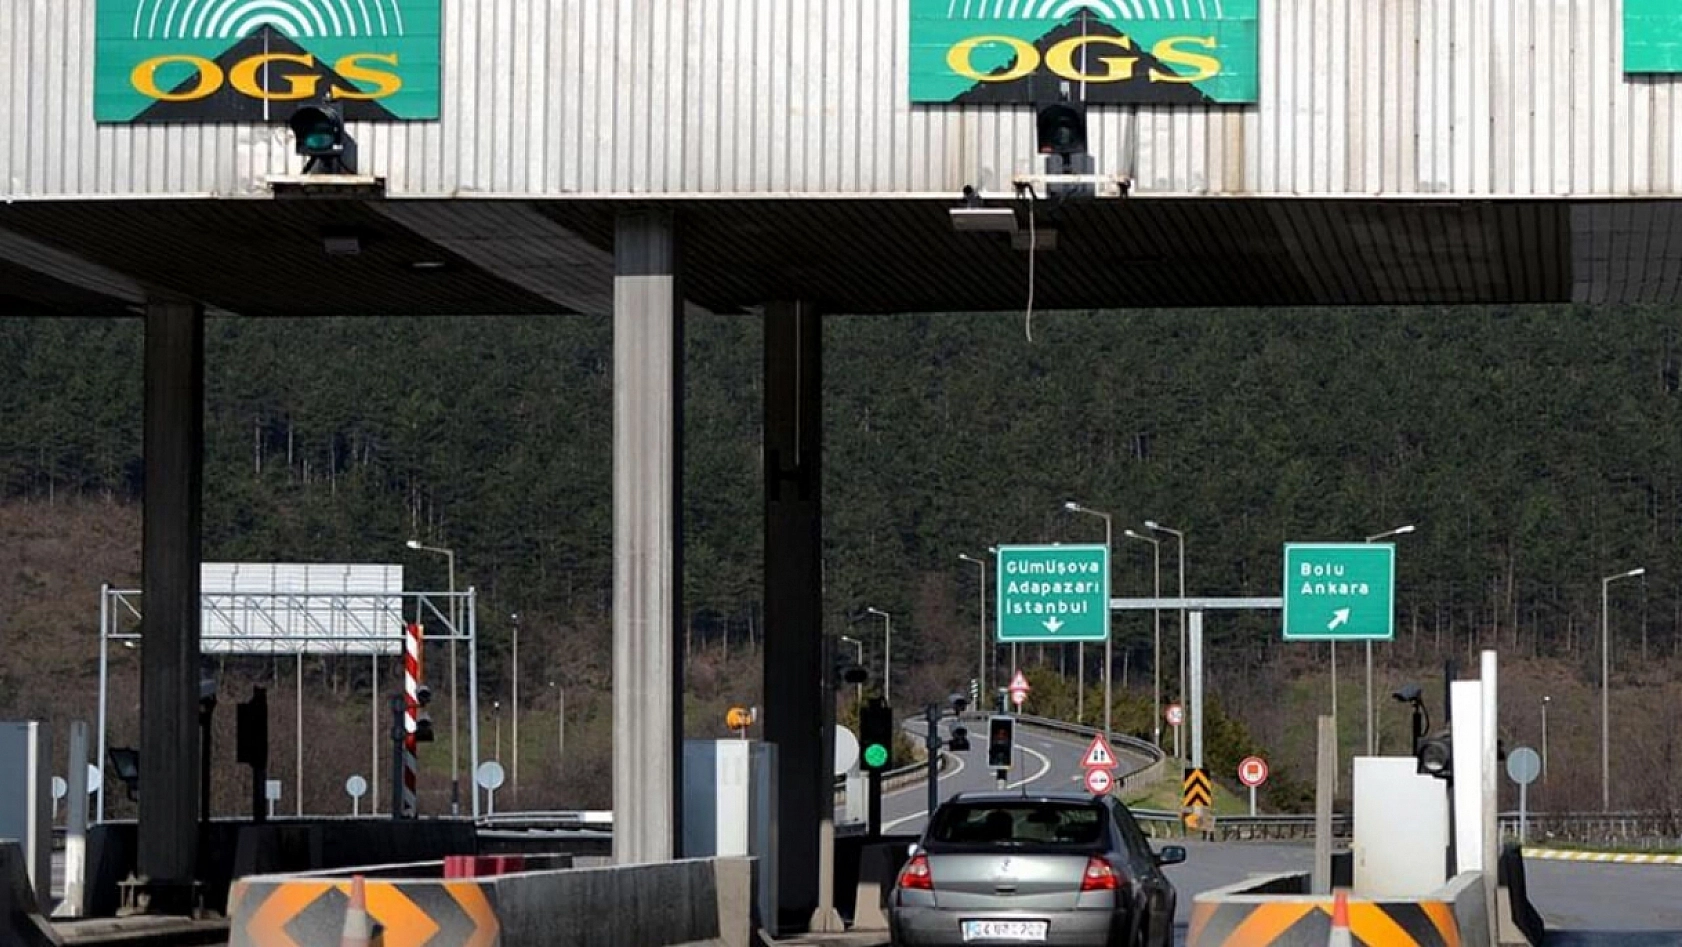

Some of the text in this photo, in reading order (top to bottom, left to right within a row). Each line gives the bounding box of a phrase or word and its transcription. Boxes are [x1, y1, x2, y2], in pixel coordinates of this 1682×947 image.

[946, 35, 1222, 82] OGS
[130, 53, 402, 102] OGS
[1006, 559, 1099, 575] Gümüşova
[1300, 562, 1345, 577] Bolu
[1007, 580, 1099, 596] Adapazarı
[1300, 581, 1369, 595] Ankara
[1006, 598, 1088, 615] İstanbul
